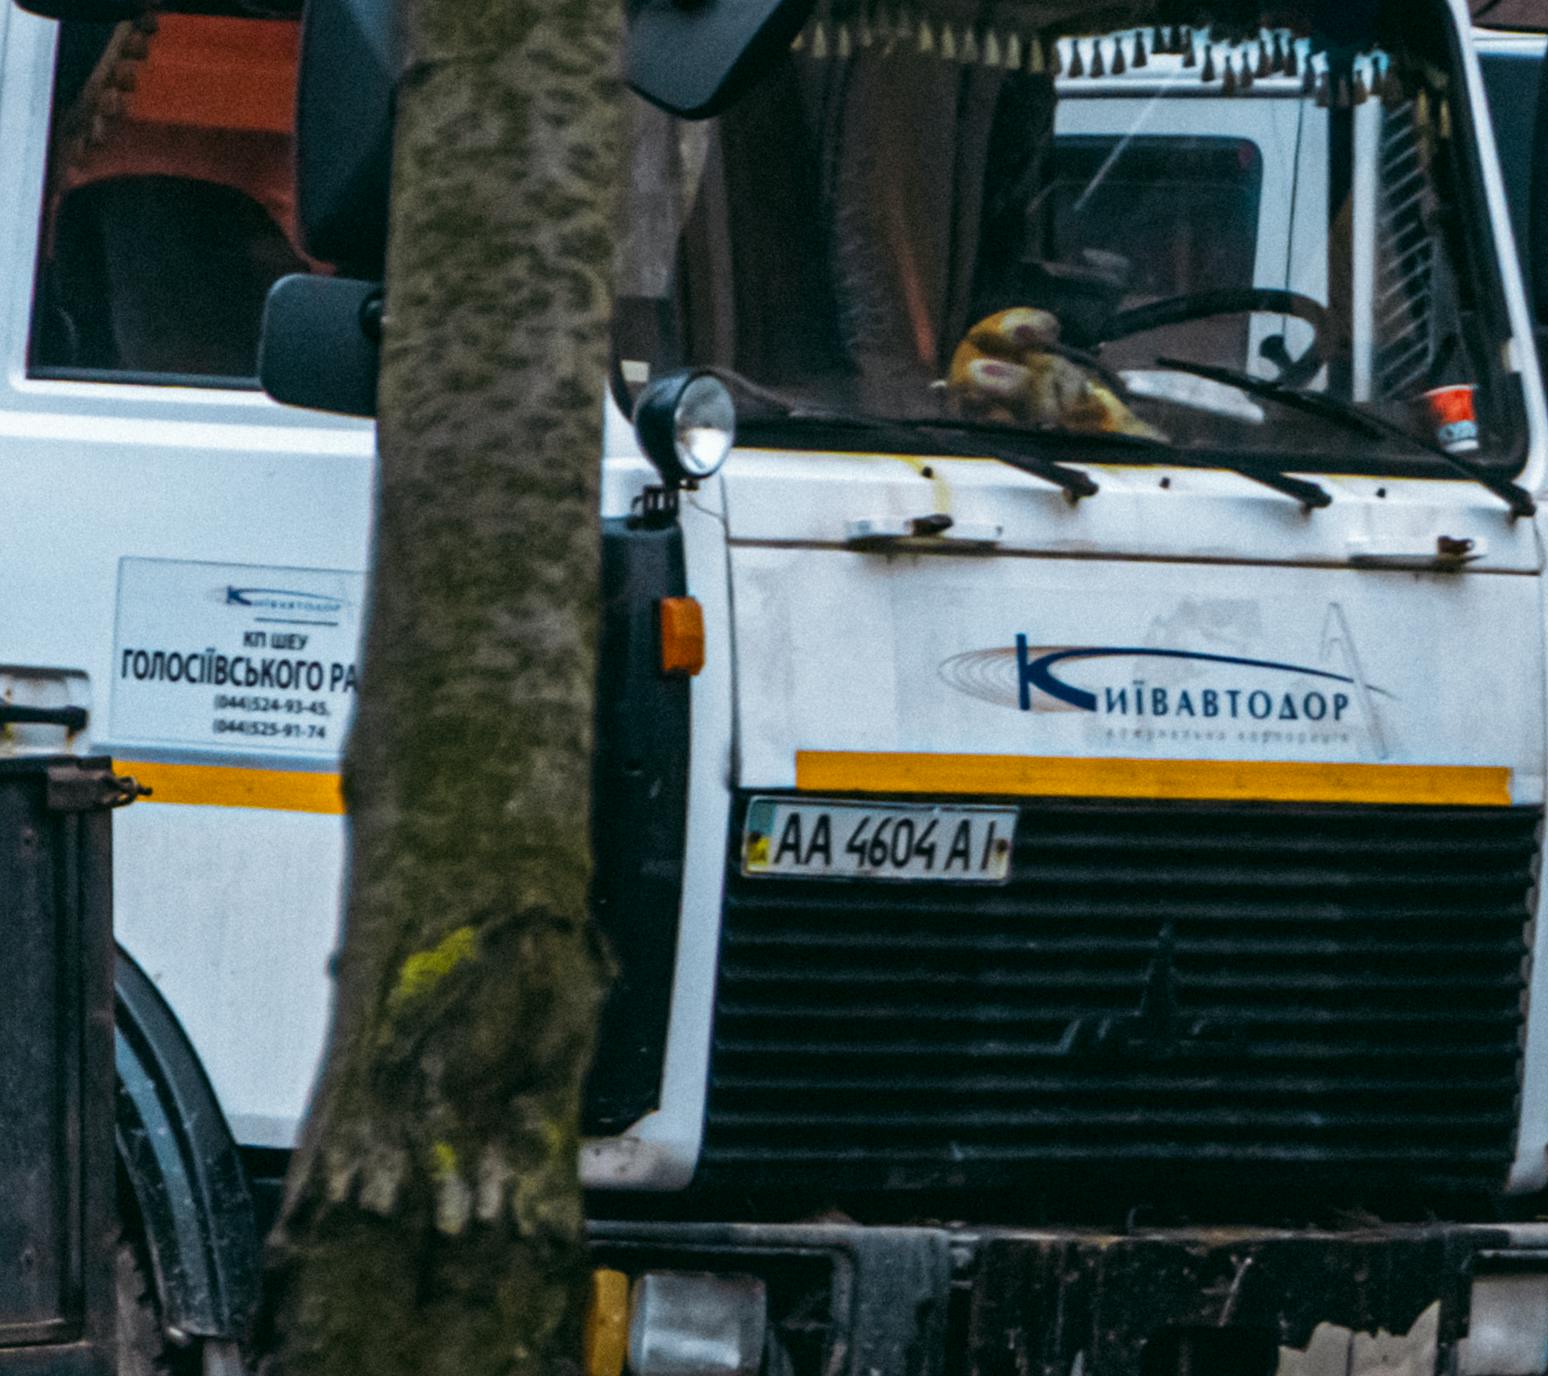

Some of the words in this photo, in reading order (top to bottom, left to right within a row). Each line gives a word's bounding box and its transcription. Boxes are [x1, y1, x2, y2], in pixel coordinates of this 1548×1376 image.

[243, 631, 267, 648] КП
[271, 634, 308, 650] ШЕУ
[121, 648, 323, 692] ГОЛОСІЇВСЬКОГО
[774, 812, 831, 865] AA
[845, 815, 940, 870] 4604
